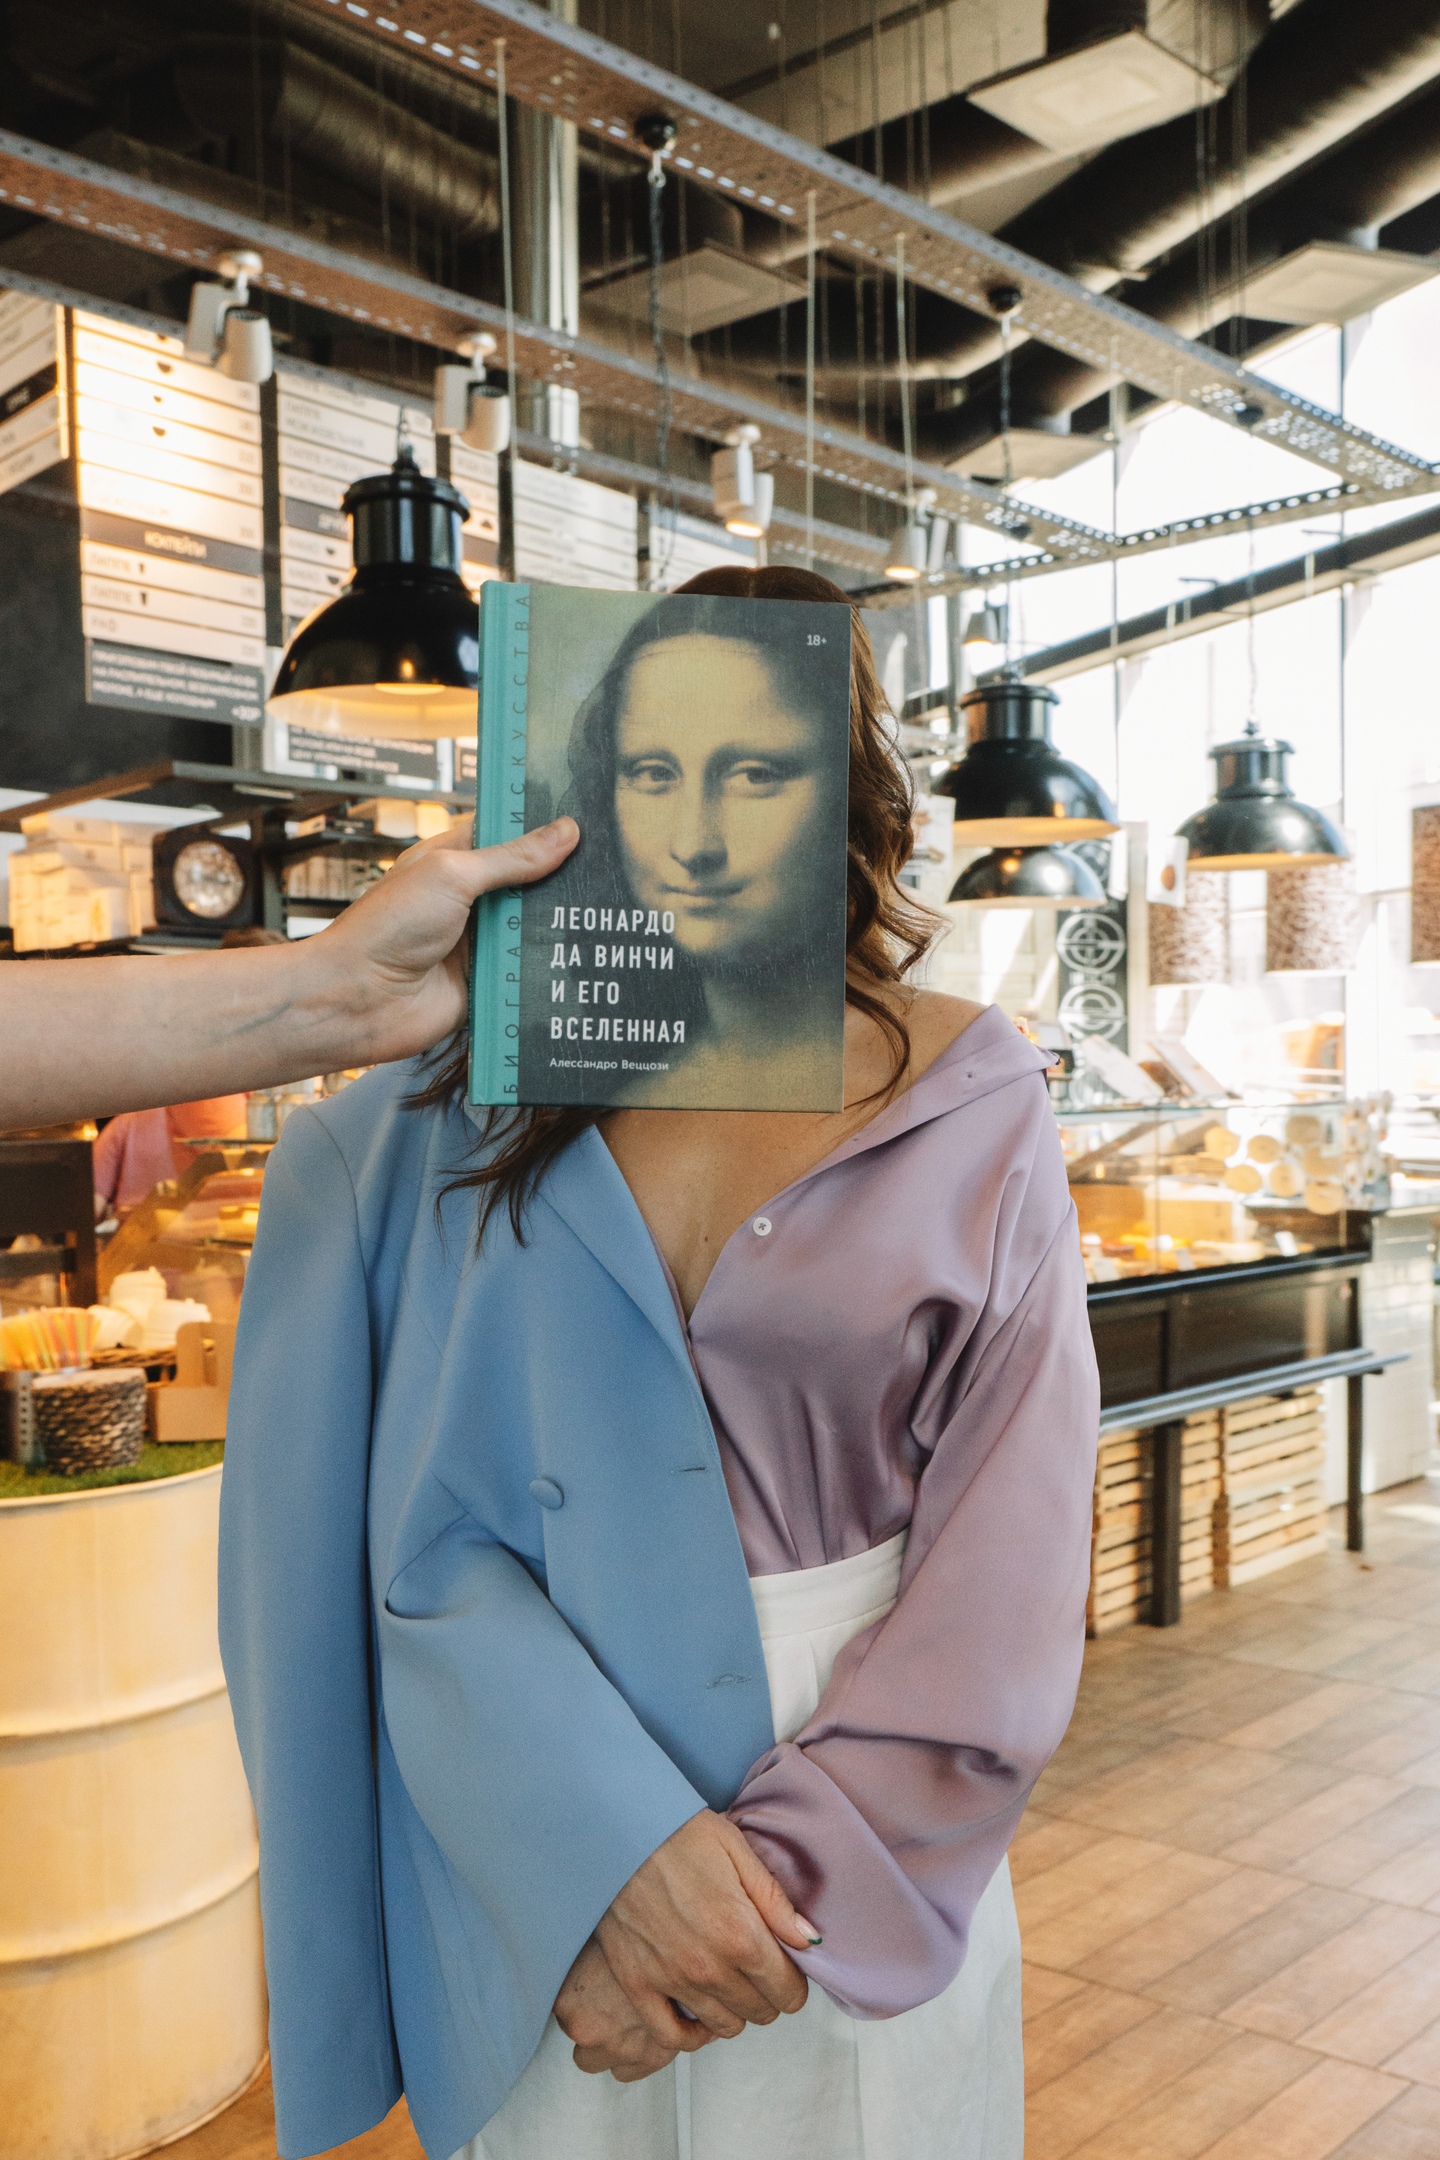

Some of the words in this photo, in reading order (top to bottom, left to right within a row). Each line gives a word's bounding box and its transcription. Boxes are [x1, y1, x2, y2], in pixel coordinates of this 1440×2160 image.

[806, 634, 828, 646] 18+
[510, 596, 531, 824] ИСКУССТВА
[551, 906, 676, 936] ЛЕОНАРДО
[551, 943, 582, 969] ДА
[595, 945, 674, 970] ВИНЧИ
[503, 887, 523, 1094] БИОГРАФИ
[551, 980, 565, 1003] И
[578, 981, 620, 1005] ЕГО
[551, 1017, 686, 1043] ВСЕЛЕННАЯ
[549, 1057, 618, 1071] Алессандро
[621, 1059, 669, 1072] Веццози
